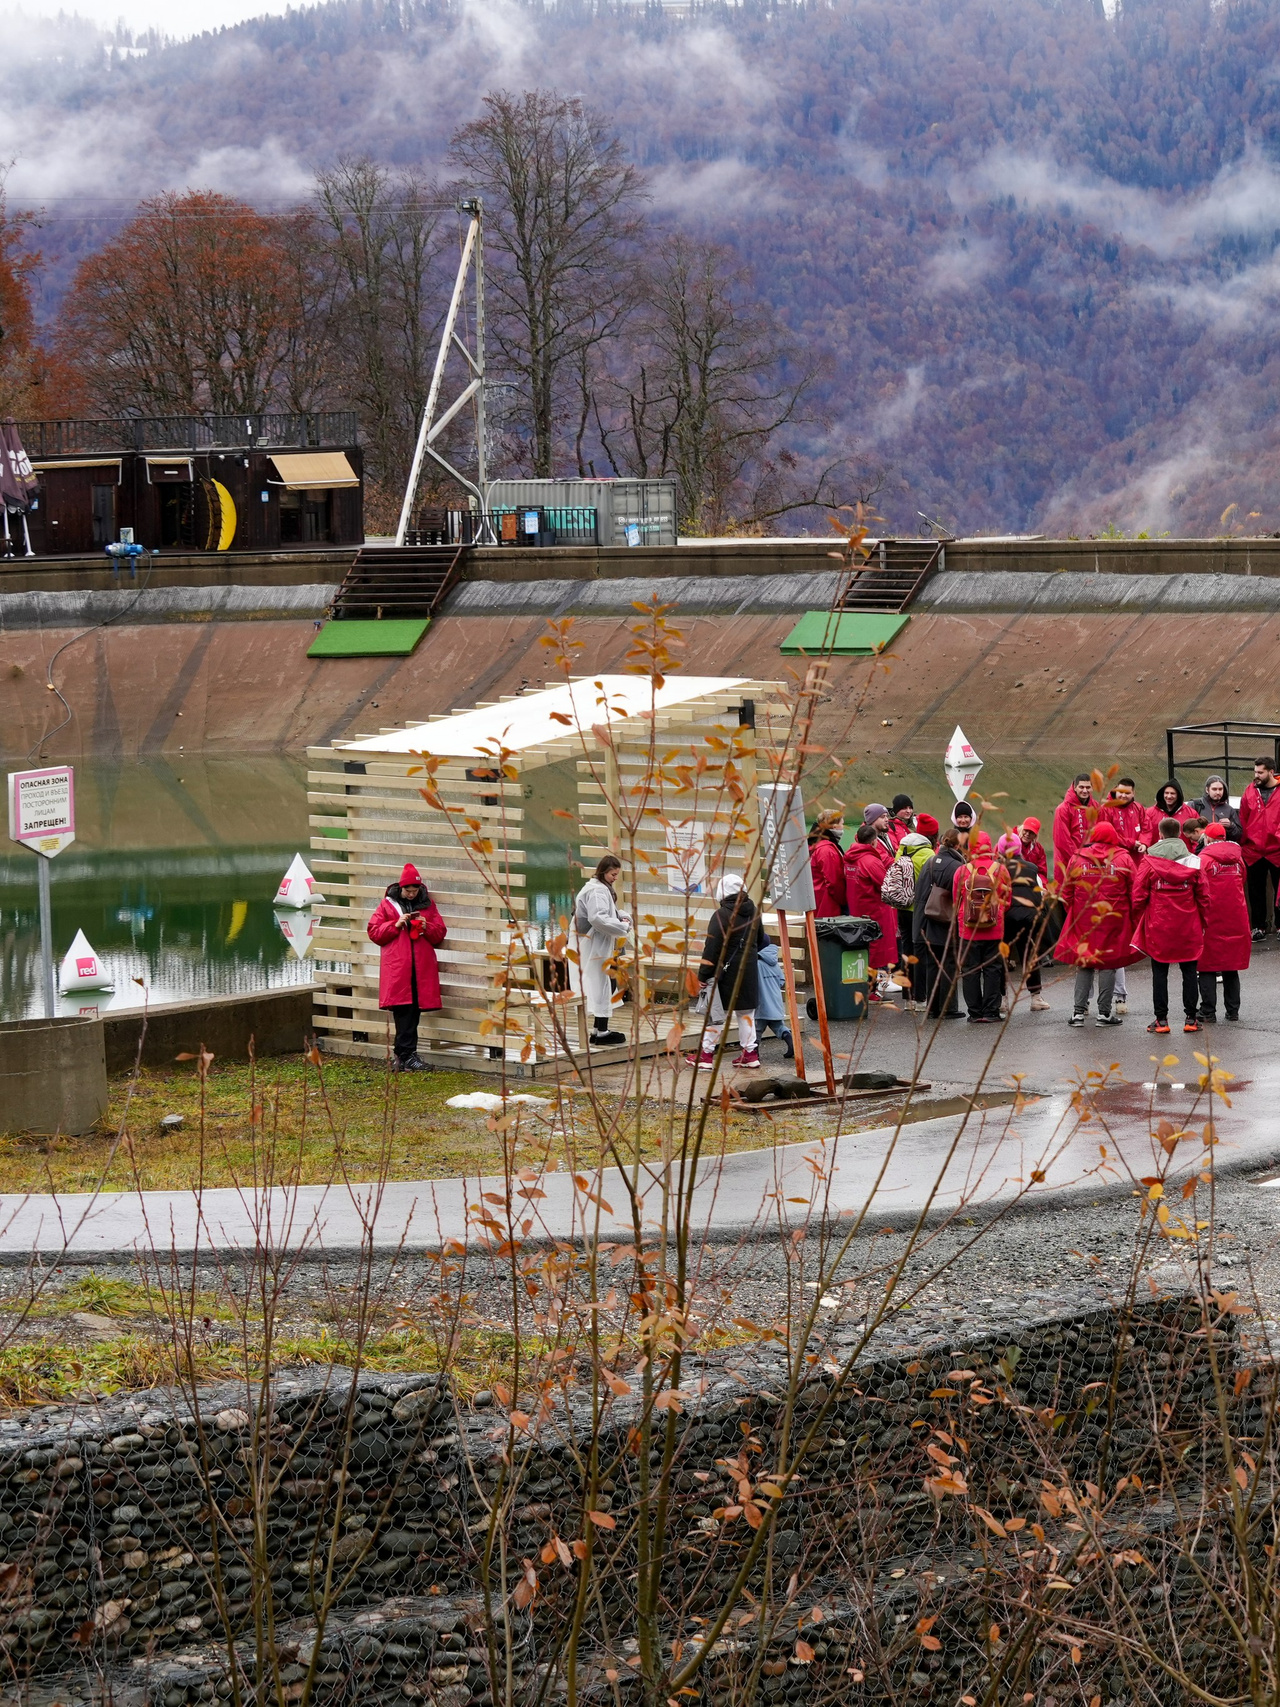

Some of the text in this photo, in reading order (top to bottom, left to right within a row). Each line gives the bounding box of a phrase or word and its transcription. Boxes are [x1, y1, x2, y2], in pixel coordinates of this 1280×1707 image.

[20, 776, 68, 789] ОПАСНАЯ ЗОНА
[21, 791, 45, 800] ПРОХОД
[50, 787, 68, 796] ВЪЕЗД
[22, 797, 67, 809] ПОСТОРОННИМ
[34, 808, 56, 817] ЛИЦАМ
[24, 817, 67, 831] ЗАПРЕЩЕН!
[779, 843, 792, 901] TRANSFER
[79, 960, 96, 976] red
